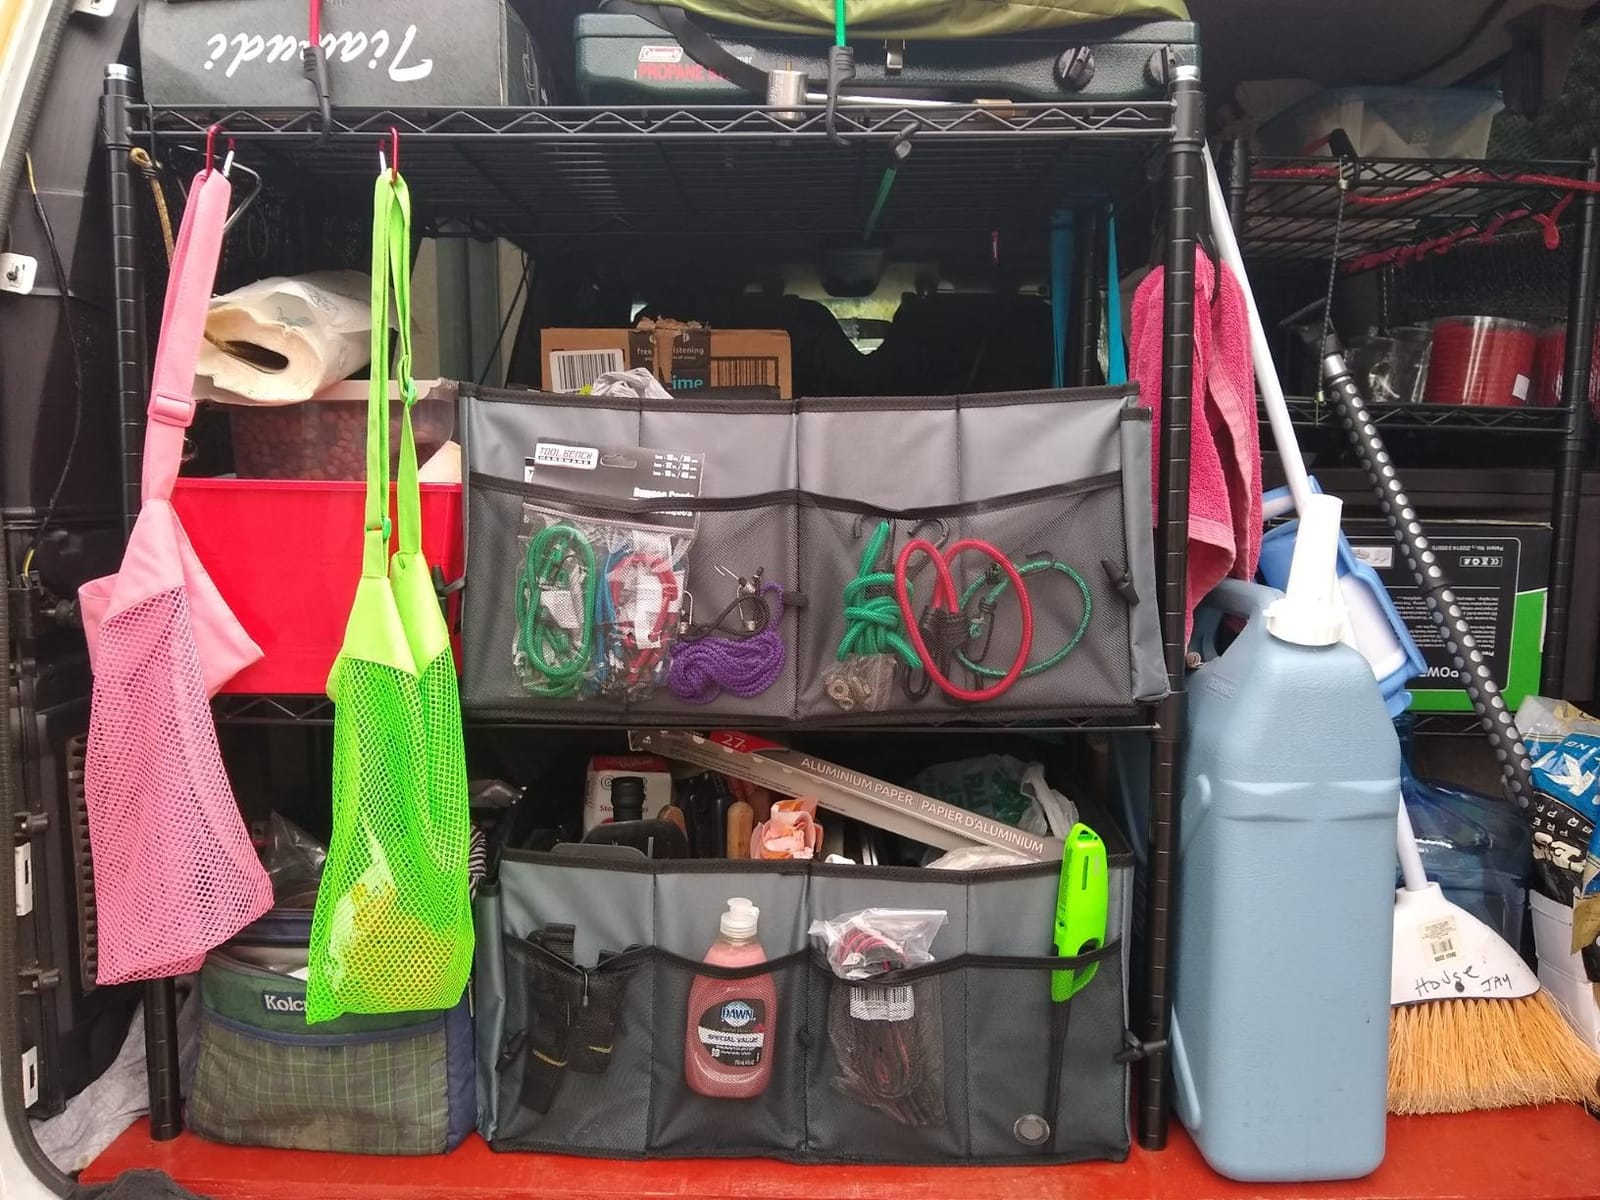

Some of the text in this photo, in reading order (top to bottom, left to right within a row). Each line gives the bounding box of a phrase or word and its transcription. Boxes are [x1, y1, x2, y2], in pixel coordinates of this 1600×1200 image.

[1419, 667, 1459, 678] POW
[722, 734, 745, 748] 27
[800, 758, 874, 791] ALUMINIUM
[874, 782, 913, 805] PAPER
[920, 799, 962, 824] PAPIER
[965, 816, 1044, 854] D'ALUMINIUM
[264, 994, 306, 1011] Kolc
[722, 1008, 753, 1019] DAWN
